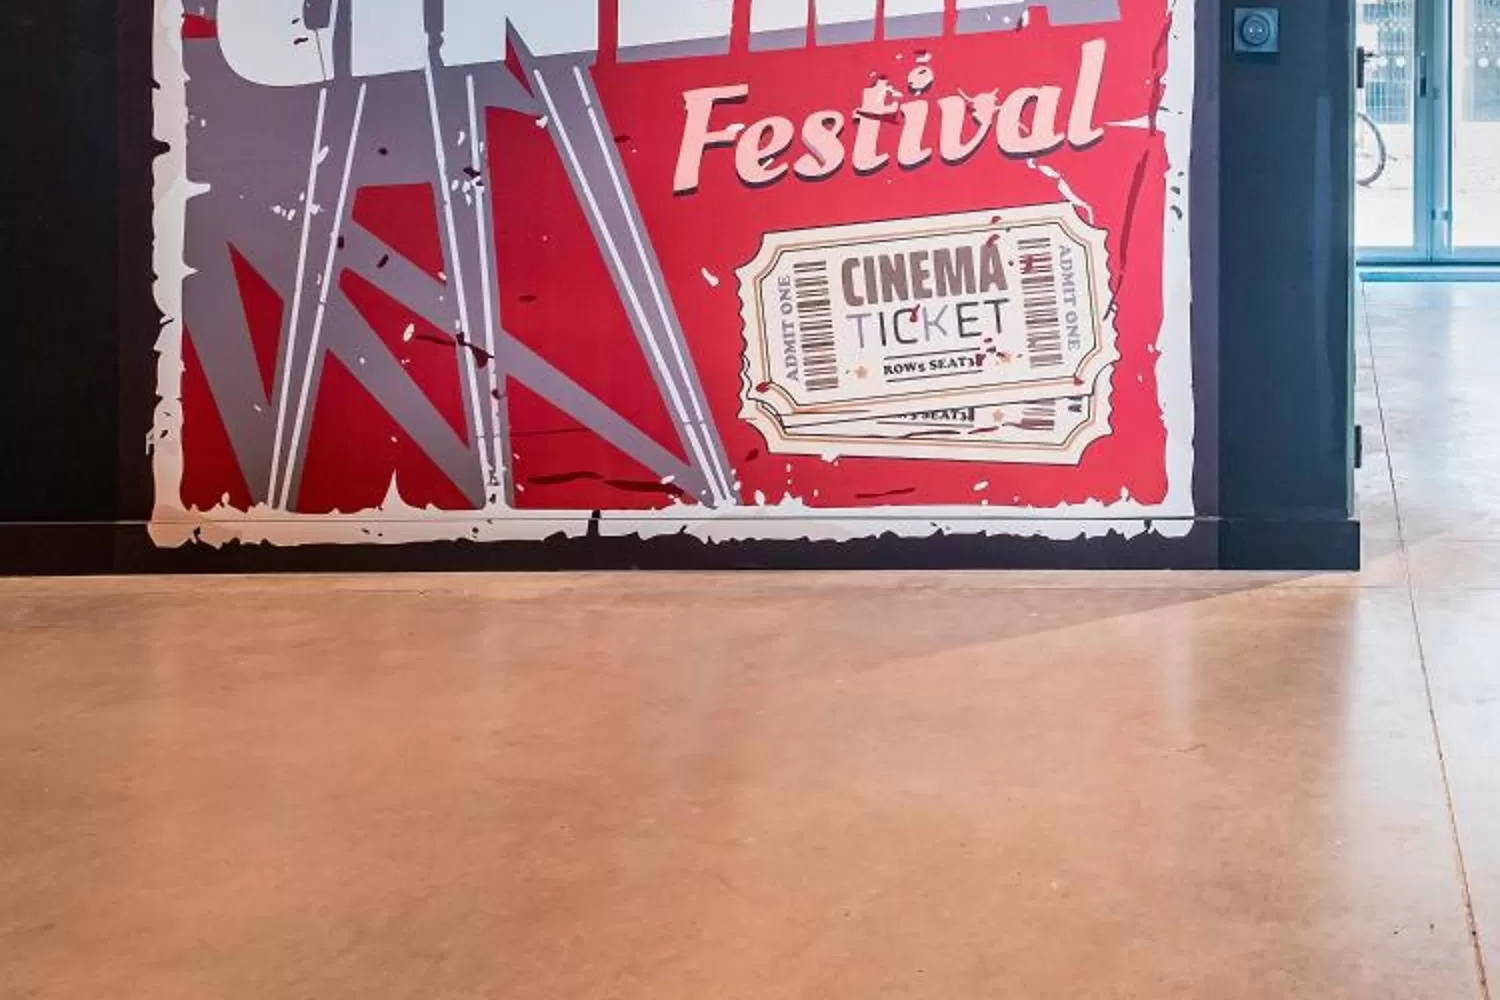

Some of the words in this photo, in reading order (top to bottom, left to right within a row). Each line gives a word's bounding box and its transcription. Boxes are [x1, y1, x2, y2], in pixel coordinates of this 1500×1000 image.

[672, 38, 1108, 198] Festival
[775, 274, 795, 315] ONE
[840, 243, 1010, 308] CINEMA
[1059, 244, 1078, 306] ADMIT
[779, 319, 801, 382] ADMIT
[845, 297, 1012, 350] TICKET
[1064, 311, 1082, 354] ONE
